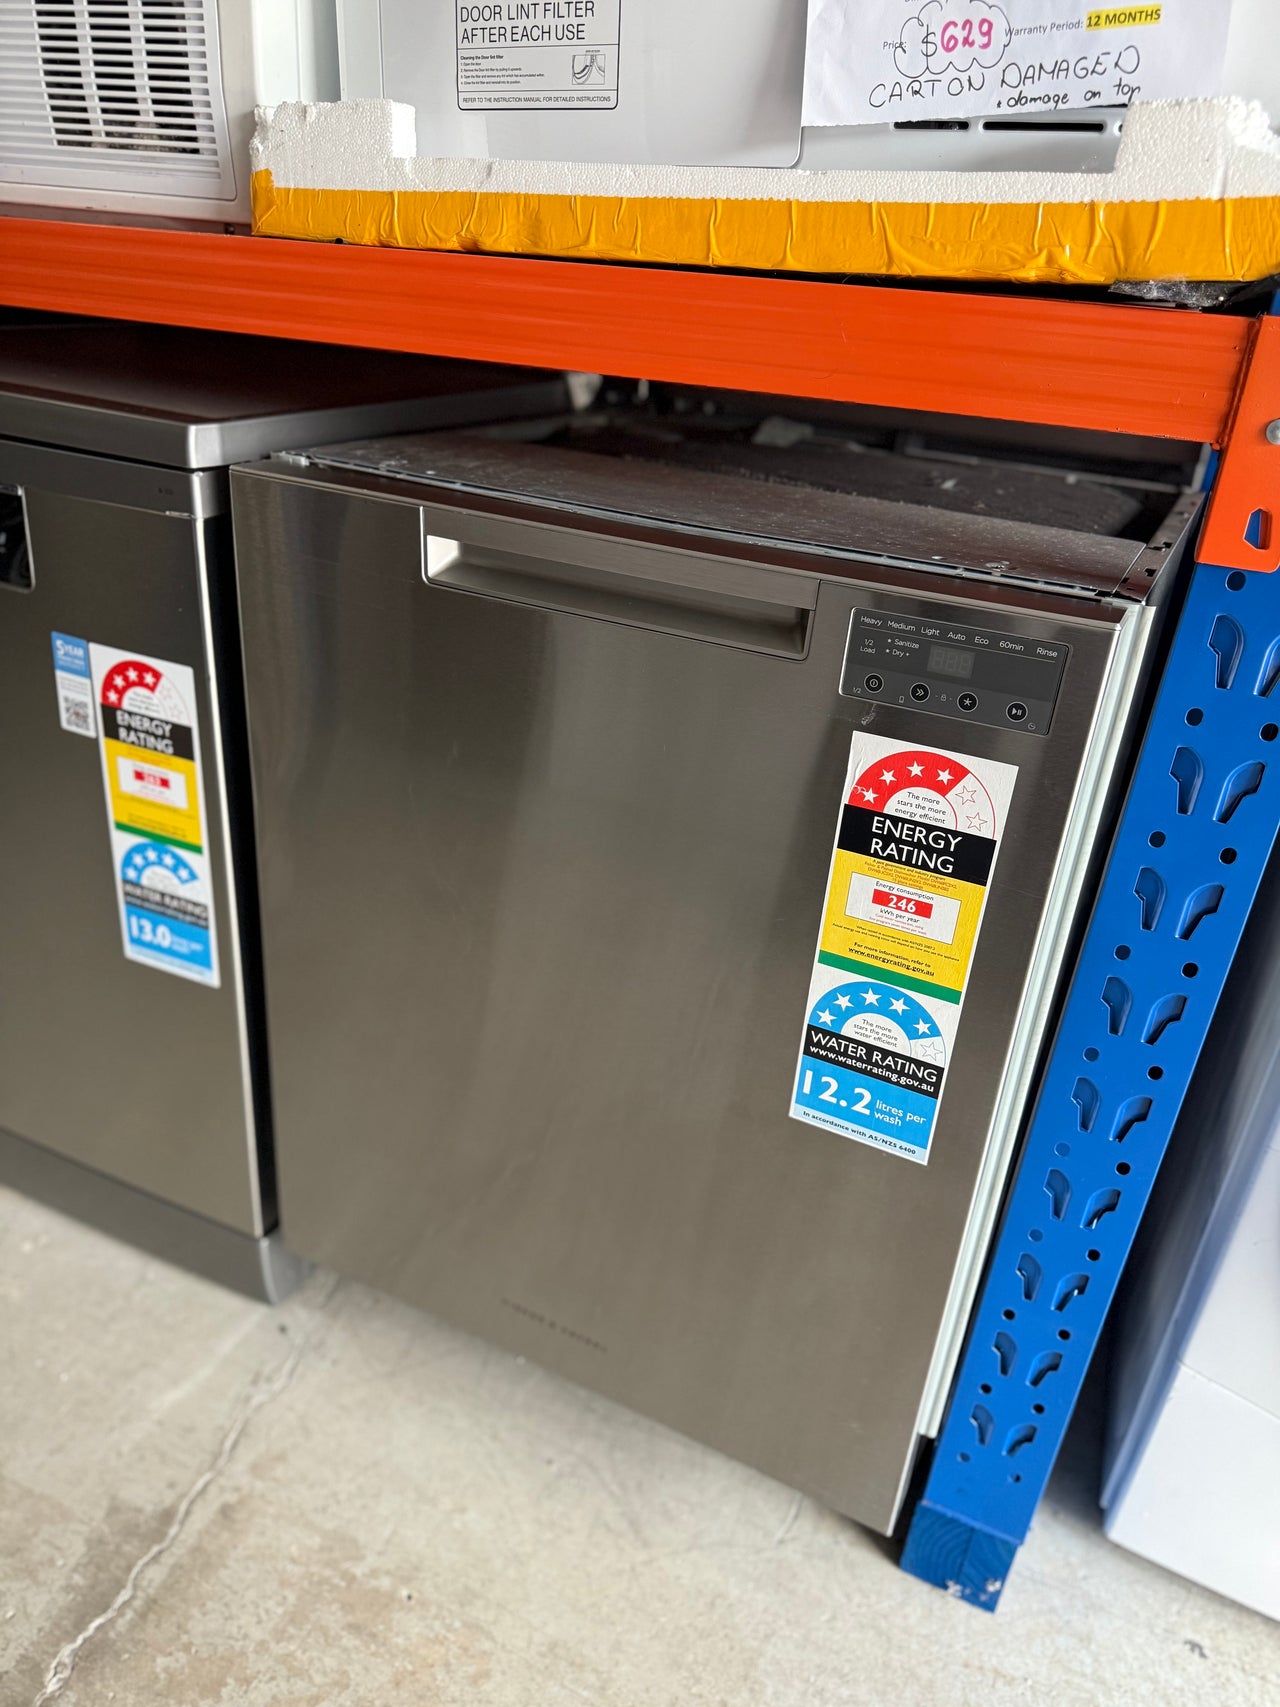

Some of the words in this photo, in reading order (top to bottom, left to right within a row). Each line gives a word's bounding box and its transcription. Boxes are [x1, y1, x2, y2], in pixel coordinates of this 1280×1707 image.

[460, 5, 503, 22] DOOR
[507, 3, 540, 20] LINT
[543, 1, 595, 18] FILTER
[461, 27, 508, 45] AFTER
[510, 25, 551, 42] EACH
[555, 24, 586, 41] USE
[1004, 23, 1048, 39] Warranty
[1050, 19, 1084, 34] Period:
[1087, 15, 1101, 27] 12
[1104, 8, 1161, 26] MONTHS
[883, 41, 907, 50] Price:
[921, 18, 994, 57] $629
[869, 72, 985, 107] CARTON
[1000, 45, 1140, 89] DAMAGED
[1007, 90, 1069, 110] damage
[1084, 90, 1101, 101] on
[1113, 78, 1141, 103] top
[860, 615, 883, 627] Heavy
[887, 620, 916, 632] Medium
[921, 626, 940, 638] Light
[947, 631, 966, 641] Auto
[974, 636, 990, 646] Eco
[999, 640, 1024, 652] 60min
[1036, 647, 1058, 658] Rinse
[894, 638, 920, 650] Sanitize
[860, 646, 876, 654] Load
[892, 648, 904, 658] Dry
[116, 710, 173, 737] ENERGY
[118, 727, 174, 755] RATING
[897, 800, 913, 809] stars
[914, 802, 926, 811] the
[928, 806, 947, 816] more
[907, 791, 920, 800] The
[921, 796, 940, 805] more
[894, 807, 917, 818] energy
[919, 812, 946, 824] efficient
[871, 816, 962, 852] ENERGY
[870, 838, 955, 873] RATING
[875, 881, 895, 891] Energy
[897, 886, 934, 901] consumption
[887, 895, 916, 913] 246
[880, 907, 894, 918] kWh
[895, 912, 906, 921] per
[907, 915, 920, 924] year
[848, 948, 935, 977] www.energyrating.gov.au
[853, 1023, 868, 1033] stars
[869, 1027, 880, 1037] the
[881, 1032, 898, 1041] more
[862, 1019, 874, 1027] The
[875, 1024, 892, 1033] more
[854, 1030, 872, 1040] water
[873, 1035, 897, 1048] efficient
[811, 1030, 867, 1060] WATER
[872, 1051, 938, 1082] RATING
[809, 1045, 935, 1093] www.waterrating.gov.au
[802, 1069, 872, 1116] 12.2
[874, 1111, 902, 1126] wash
[876, 1100, 903, 1117] litres
[906, 1113, 926, 1124] per
[812, 1114, 849, 1131] accordance
[851, 1127, 866, 1138] with
[868, 1132, 897, 1148] AS/NZS
[898, 1144, 916, 1155] 6400
